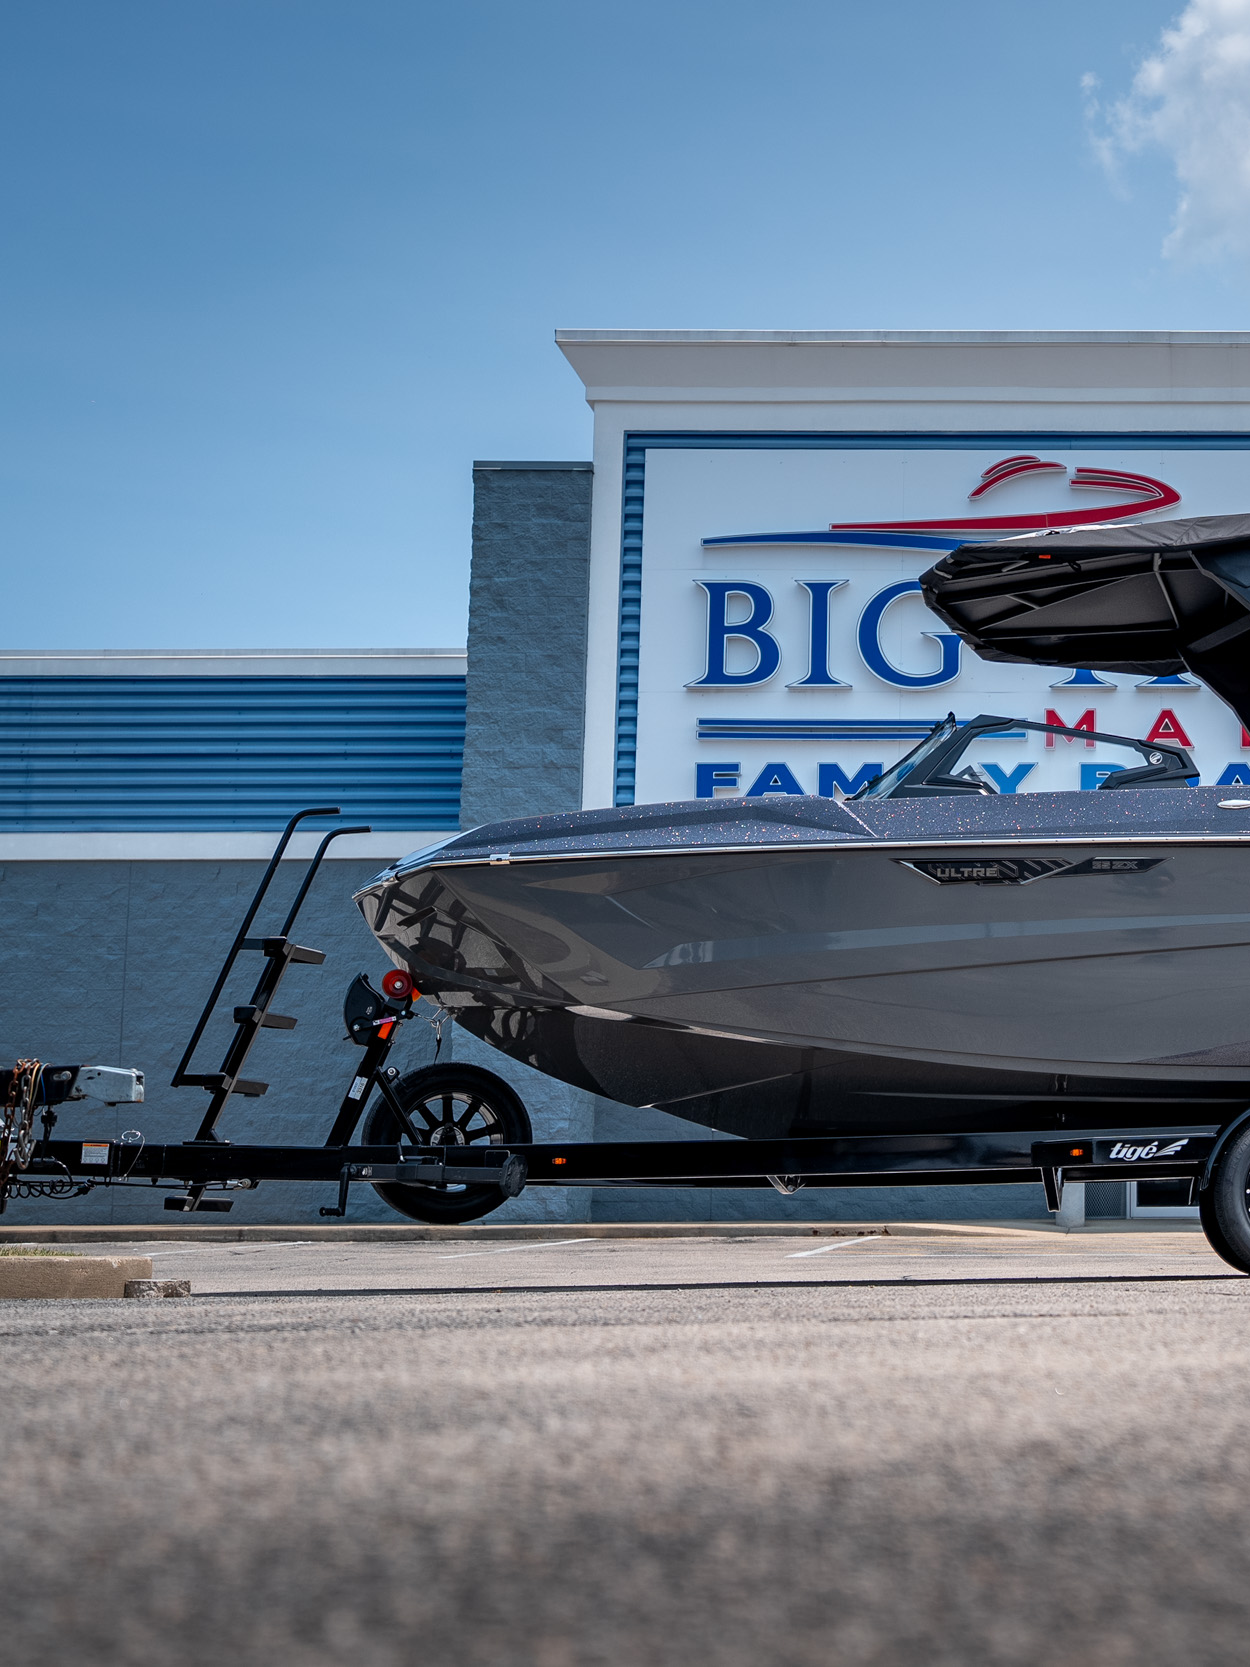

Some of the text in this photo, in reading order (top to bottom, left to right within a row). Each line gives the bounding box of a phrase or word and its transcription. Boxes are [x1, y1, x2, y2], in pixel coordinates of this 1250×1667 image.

[683, 578, 964, 690] BIG
[695, 762, 1039, 799] FAMY
[1109, 1141, 1158, 1162] tigé
